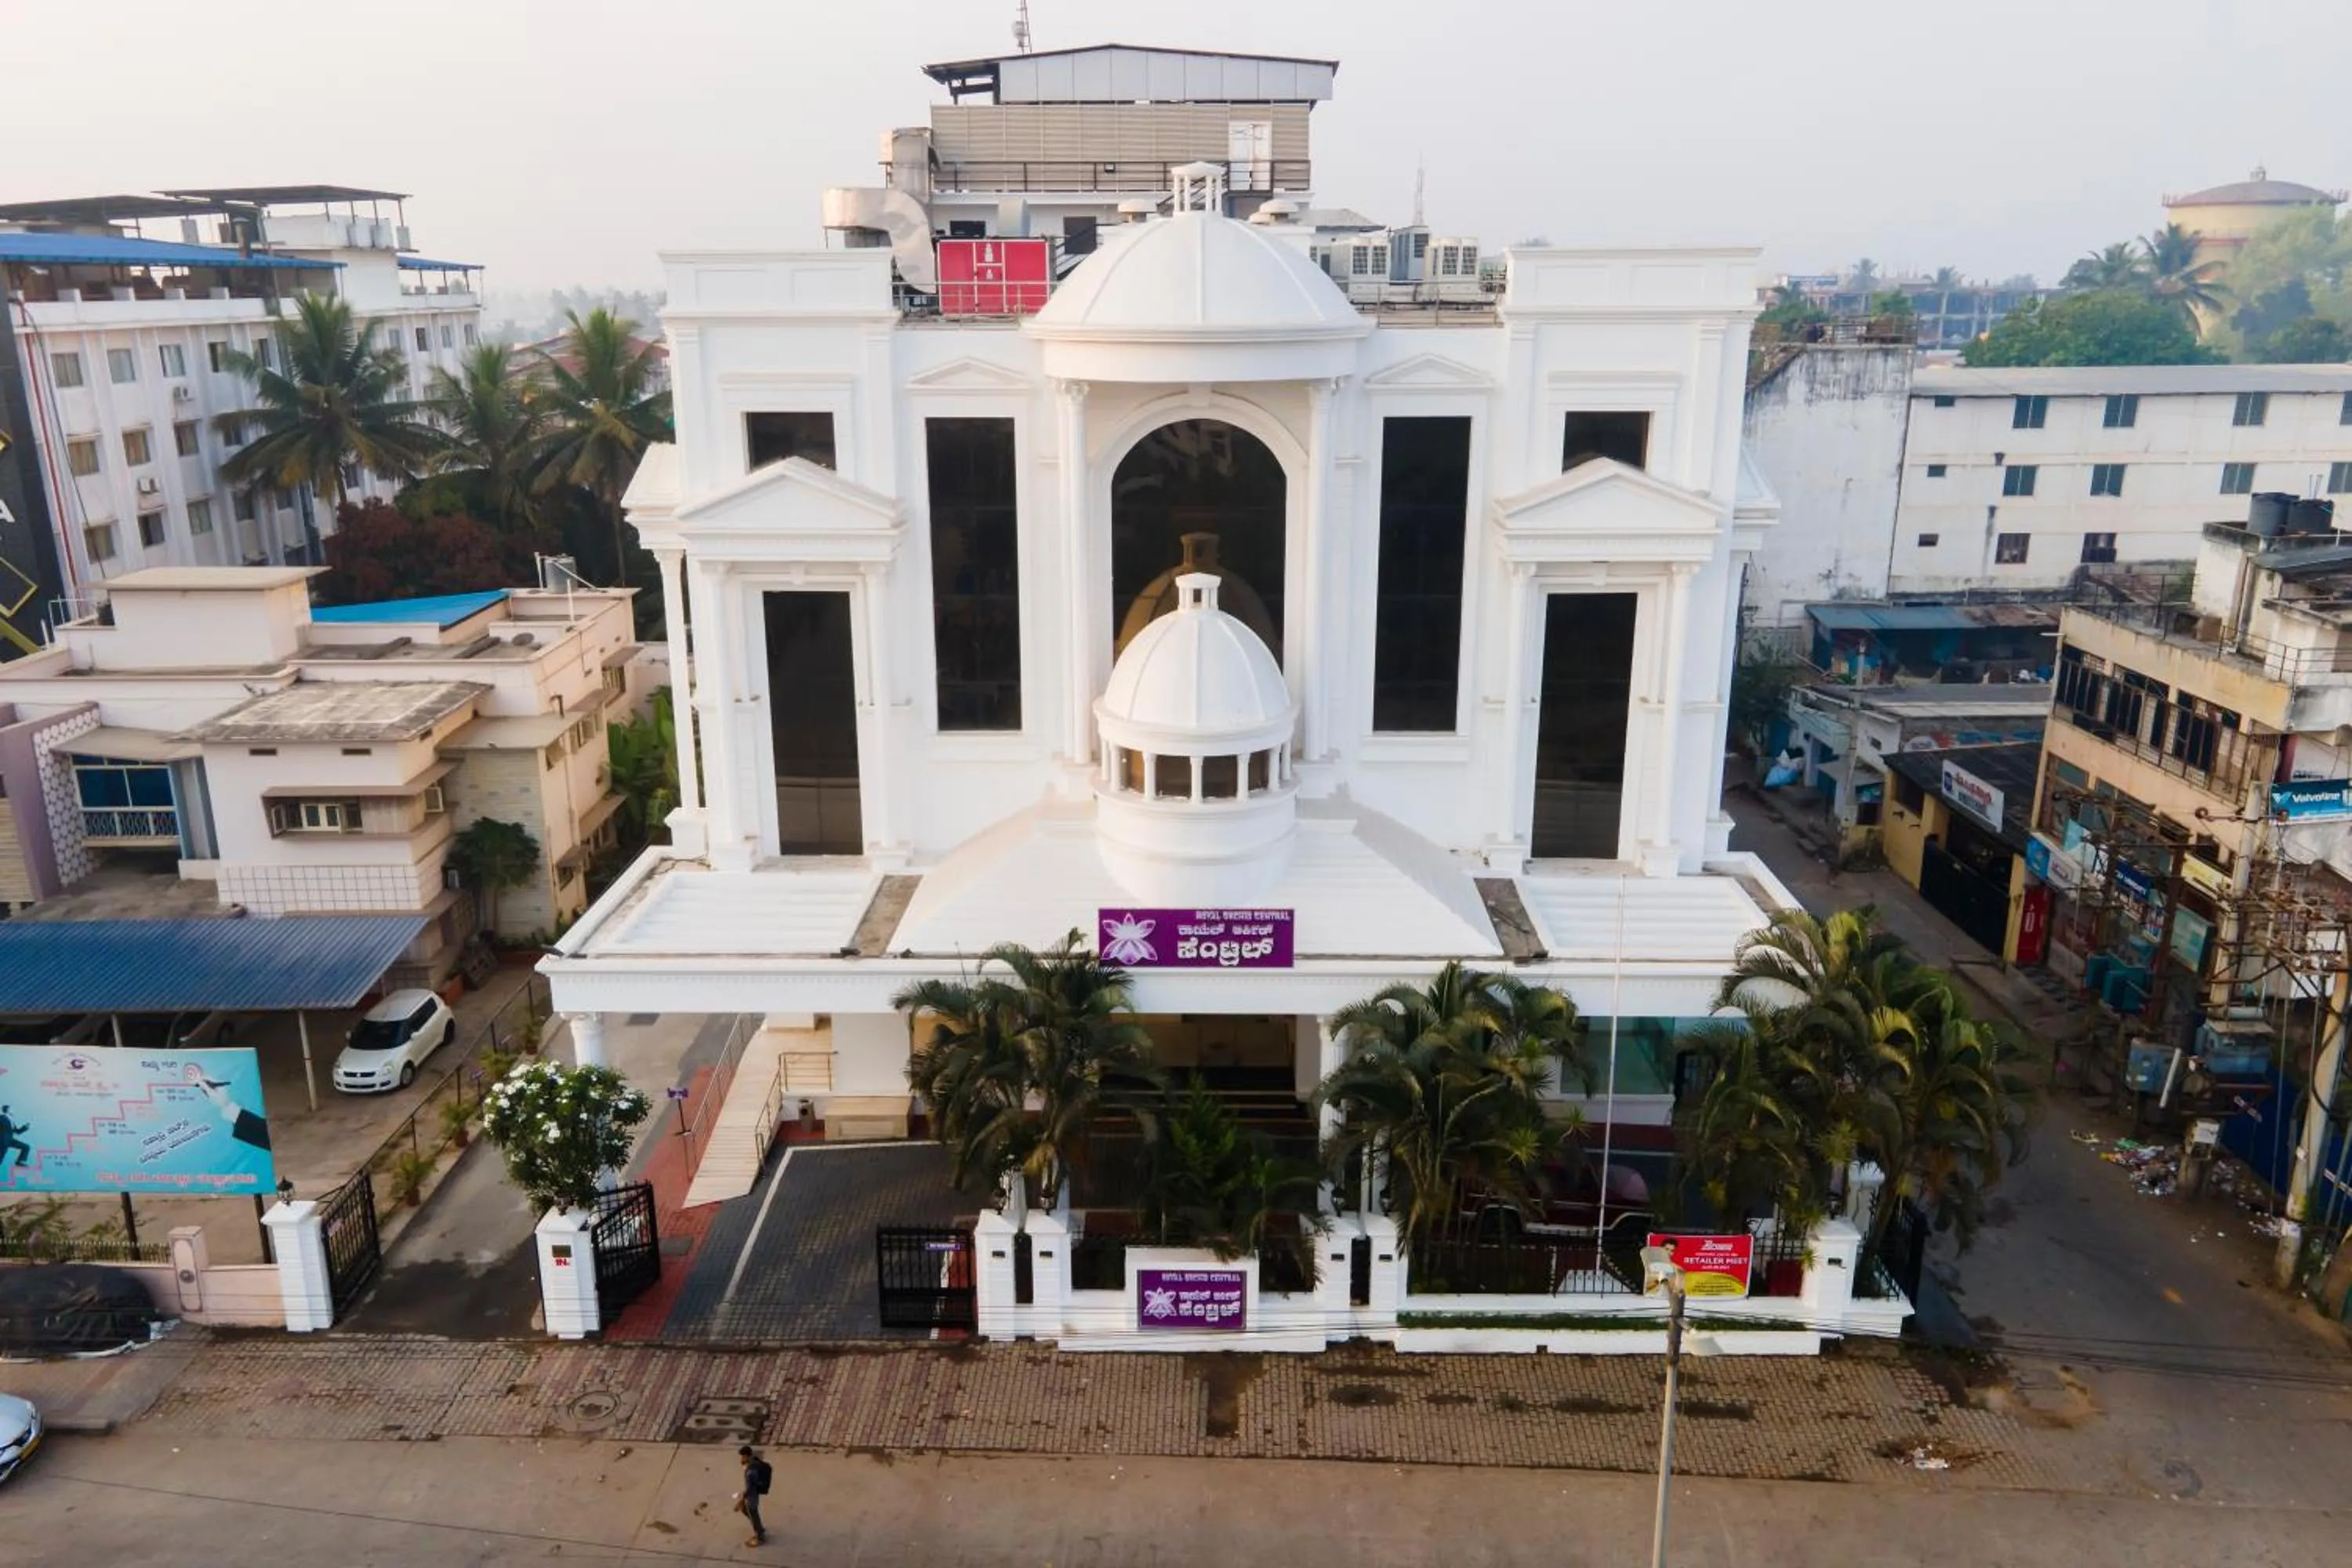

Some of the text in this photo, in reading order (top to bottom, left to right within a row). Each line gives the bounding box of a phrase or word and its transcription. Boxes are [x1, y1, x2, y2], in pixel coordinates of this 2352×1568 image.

[2292, 792, 2340, 804] Valvoline
[1196, 911, 1220, 920] ROYAL
[1254, 911, 1290, 921] CENTRAL
